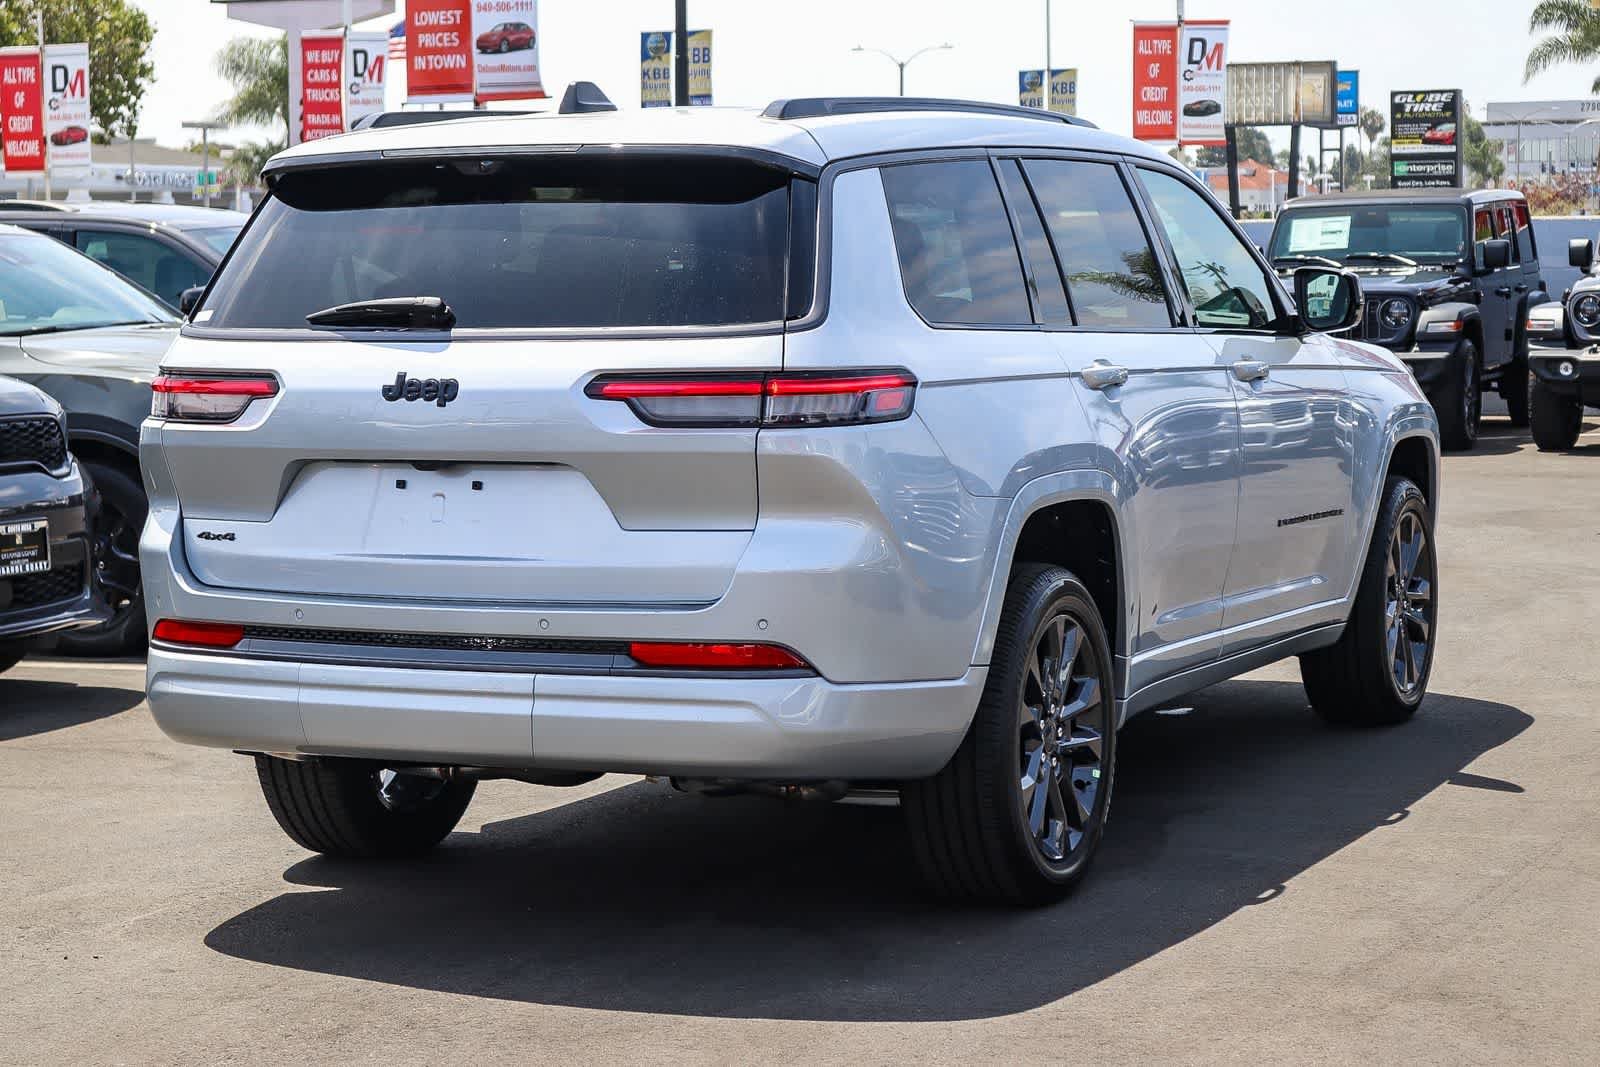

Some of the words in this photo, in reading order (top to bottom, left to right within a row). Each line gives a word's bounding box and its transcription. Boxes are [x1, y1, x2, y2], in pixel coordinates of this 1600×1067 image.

[414, 9, 463, 26] LOWEST
[418, 32, 460, 48] PRICES
[1138, 39, 1153, 54] ALL
[1154, 39, 1172, 55] TYPE
[306, 50, 321, 65] WE
[321, 48, 340, 64] BUY
[414, 56, 426, 70] IN
[428, 54, 467, 70] TOWN
[688, 47, 711, 64] BB
[3, 66, 17, 84] ALL
[17, 66, 36, 84] TYPE
[307, 69, 330, 83] CARS
[331, 68, 338, 81] &
[1149, 63, 1160, 79] OF
[306, 88, 340, 102] TRUCKS
[1051, 81, 1076, 95] KBB
[1142, 86, 1168, 102] CREDIT
[14, 91, 25, 109] OF
[1403, 102, 1445, 113] TIRE
[8, 115, 33, 133] CREDIT
[1136, 109, 1173, 125] WELCOME
[6, 140, 40, 158] WELCOME
[381, 372, 459, 407] Jeep
[197, 531, 236, 542] 4x4
